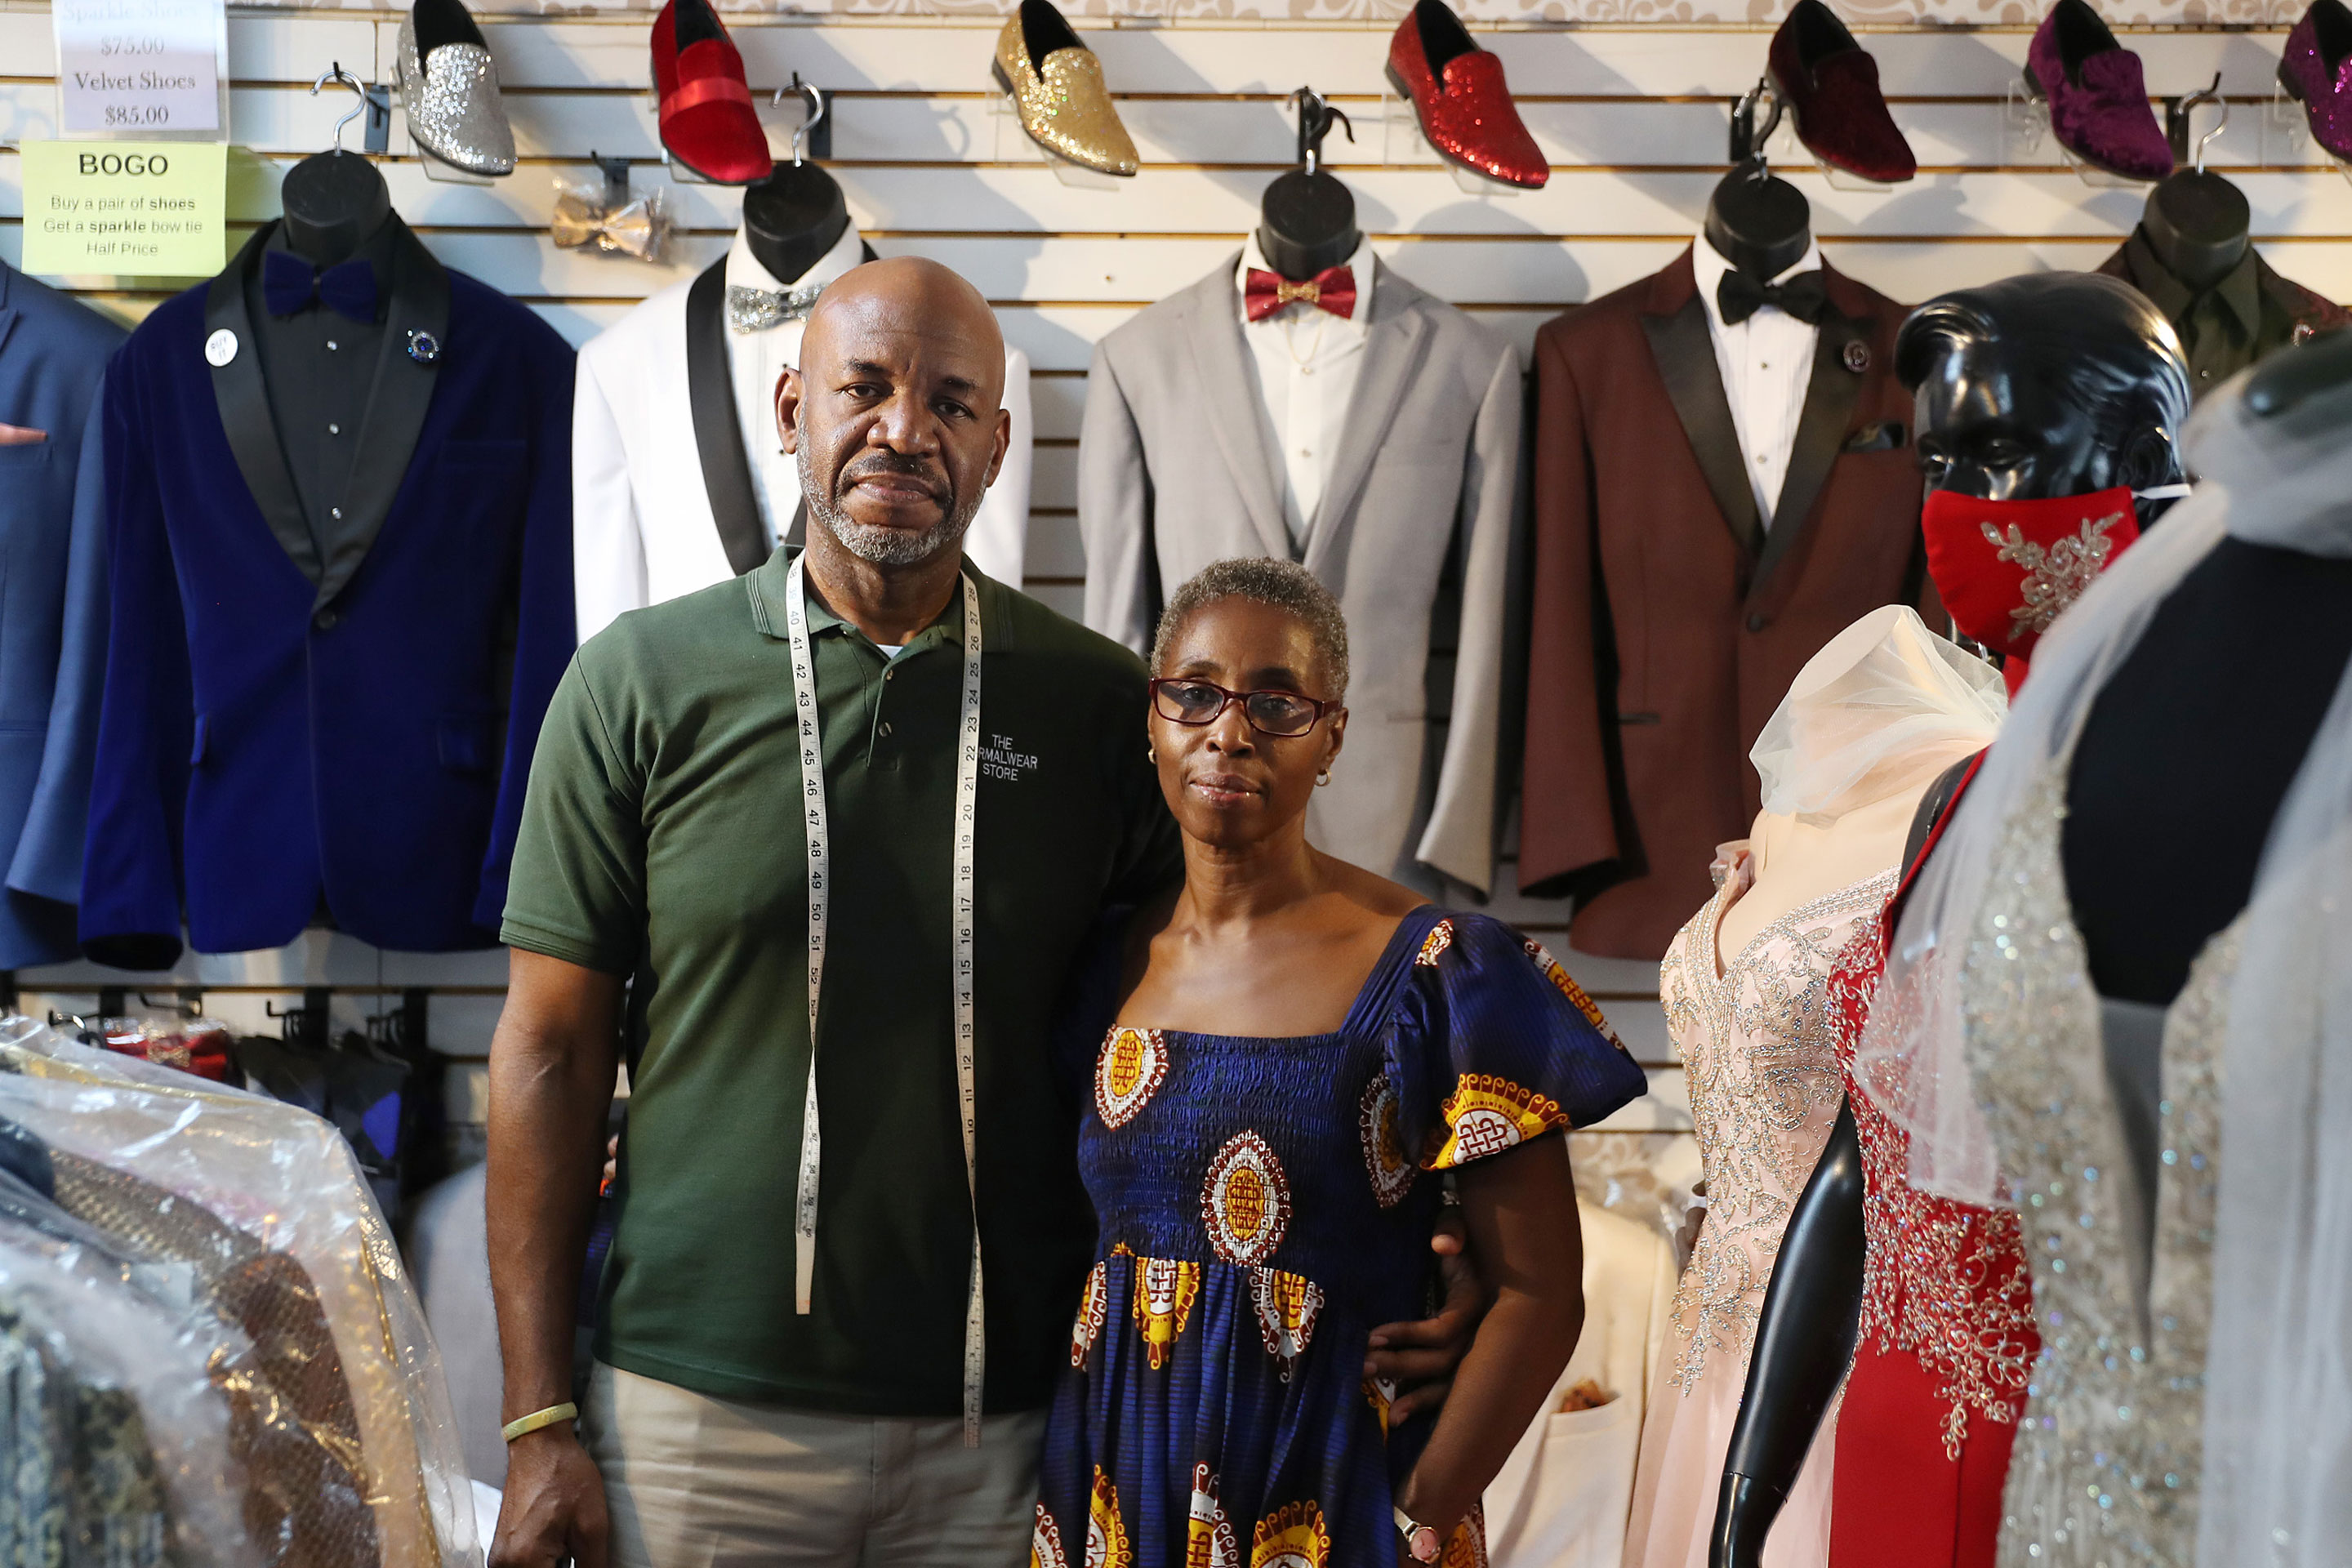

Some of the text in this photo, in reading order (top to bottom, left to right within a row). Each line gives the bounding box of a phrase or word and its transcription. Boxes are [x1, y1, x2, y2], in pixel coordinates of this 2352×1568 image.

[62, 0, 134, 24] Sparkle
[101, 35, 165, 56] $75.00
[75, 70, 196, 91] Velvet Shoes
[105, 105, 169, 126] $85.00
[79, 154, 168, 176] BOGO
[51, 196, 196, 212] Buy a pair of shoes
[43, 219, 203, 235] Get a sparkle bow tie
[87, 241, 158, 256] Half Price
[791, 611, 800, 625] 40
[792, 636, 803, 651] 41
[795, 663, 806, 679] 42
[799, 691, 810, 707] 43
[802, 719, 813, 736] 44
[992, 733, 1013, 750] THE
[804, 749, 815, 765] 45
[978, 746, 1038, 769] RMALWEAR
[982, 763, 1018, 782] STORE
[807, 779, 817, 796] 46
[809, 809, 819, 826] 47
[811, 840, 822, 858] 48
[960, 587, 979, 1134] 10 11 12 13 14 15 16 17 18 19 20 21 22 23 24 25 26 27 28
[811, 871, 822, 889] 49
[811, 903, 822, 921] 50
[811, 935, 820, 951] 51
[810, 967, 818, 985] 52
